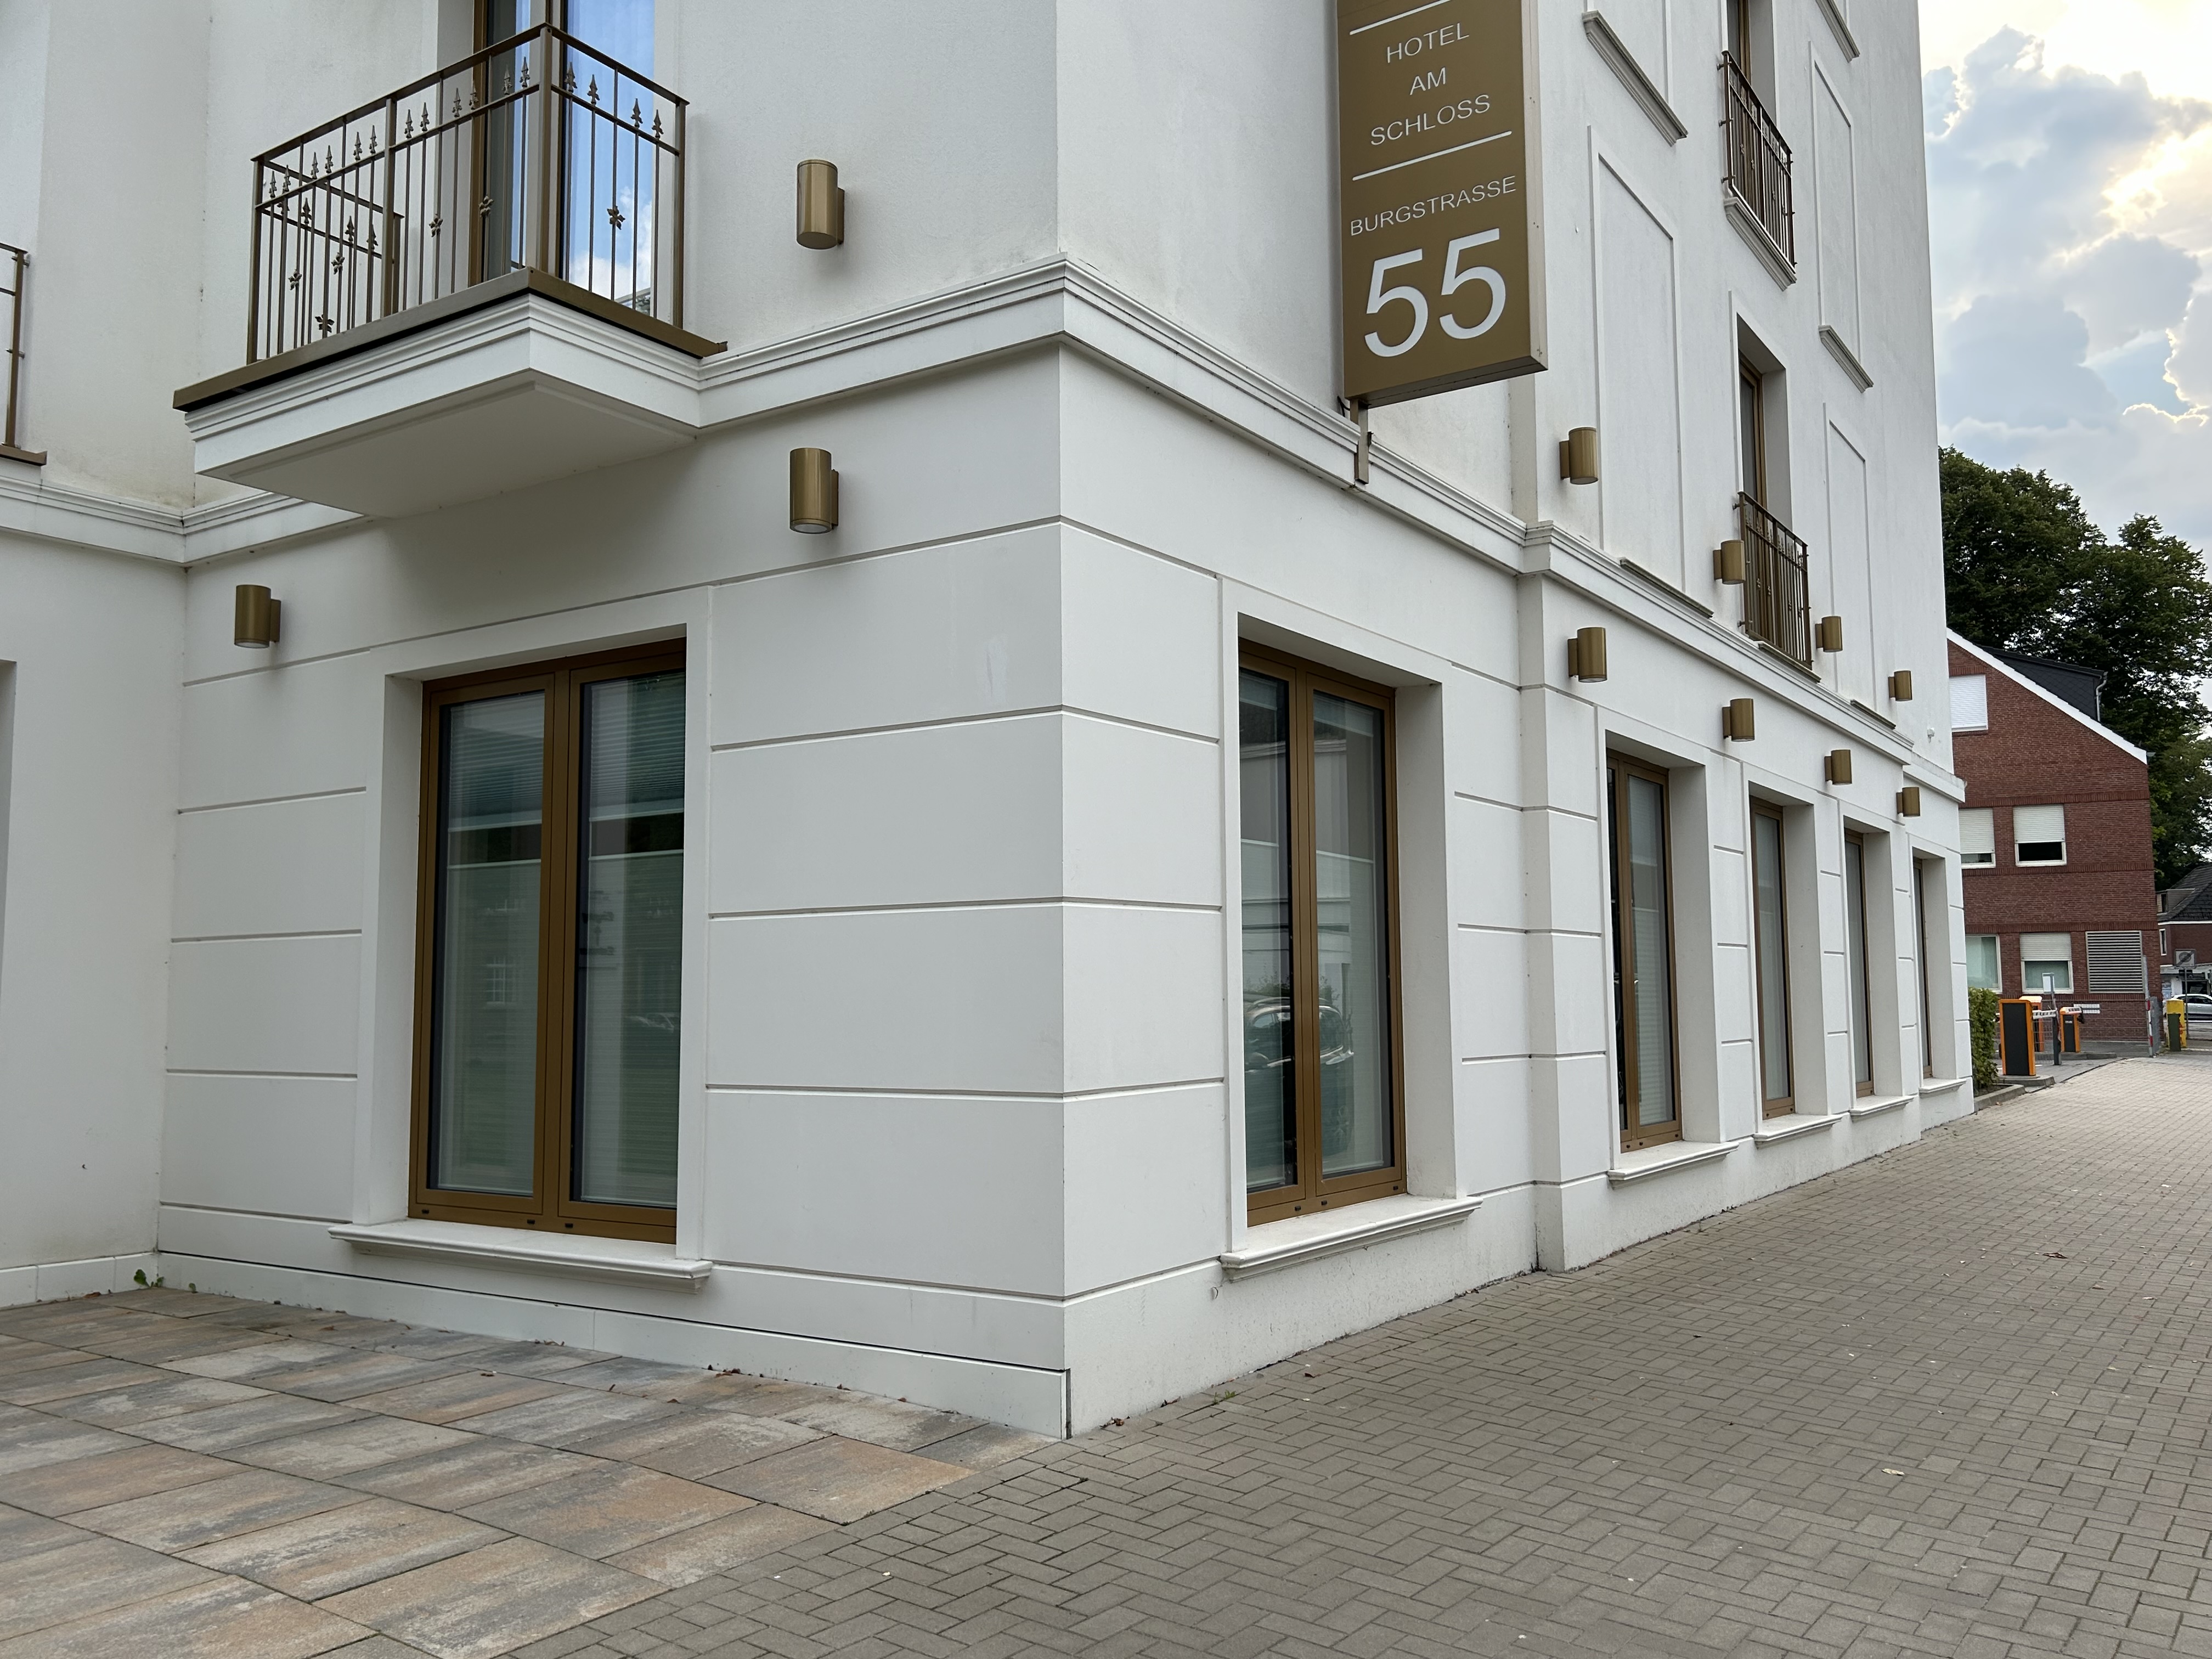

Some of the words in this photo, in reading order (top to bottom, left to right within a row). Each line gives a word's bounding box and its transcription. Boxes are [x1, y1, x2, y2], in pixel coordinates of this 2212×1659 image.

[1387, 22, 1470, 63] HOTEL
[1409, 67, 1446, 95] AM
[1370, 94, 1490, 145] SCHLOSS
[1350, 176, 1517, 236] BURGSTRASSE
[1364, 228, 1506, 357] 55
